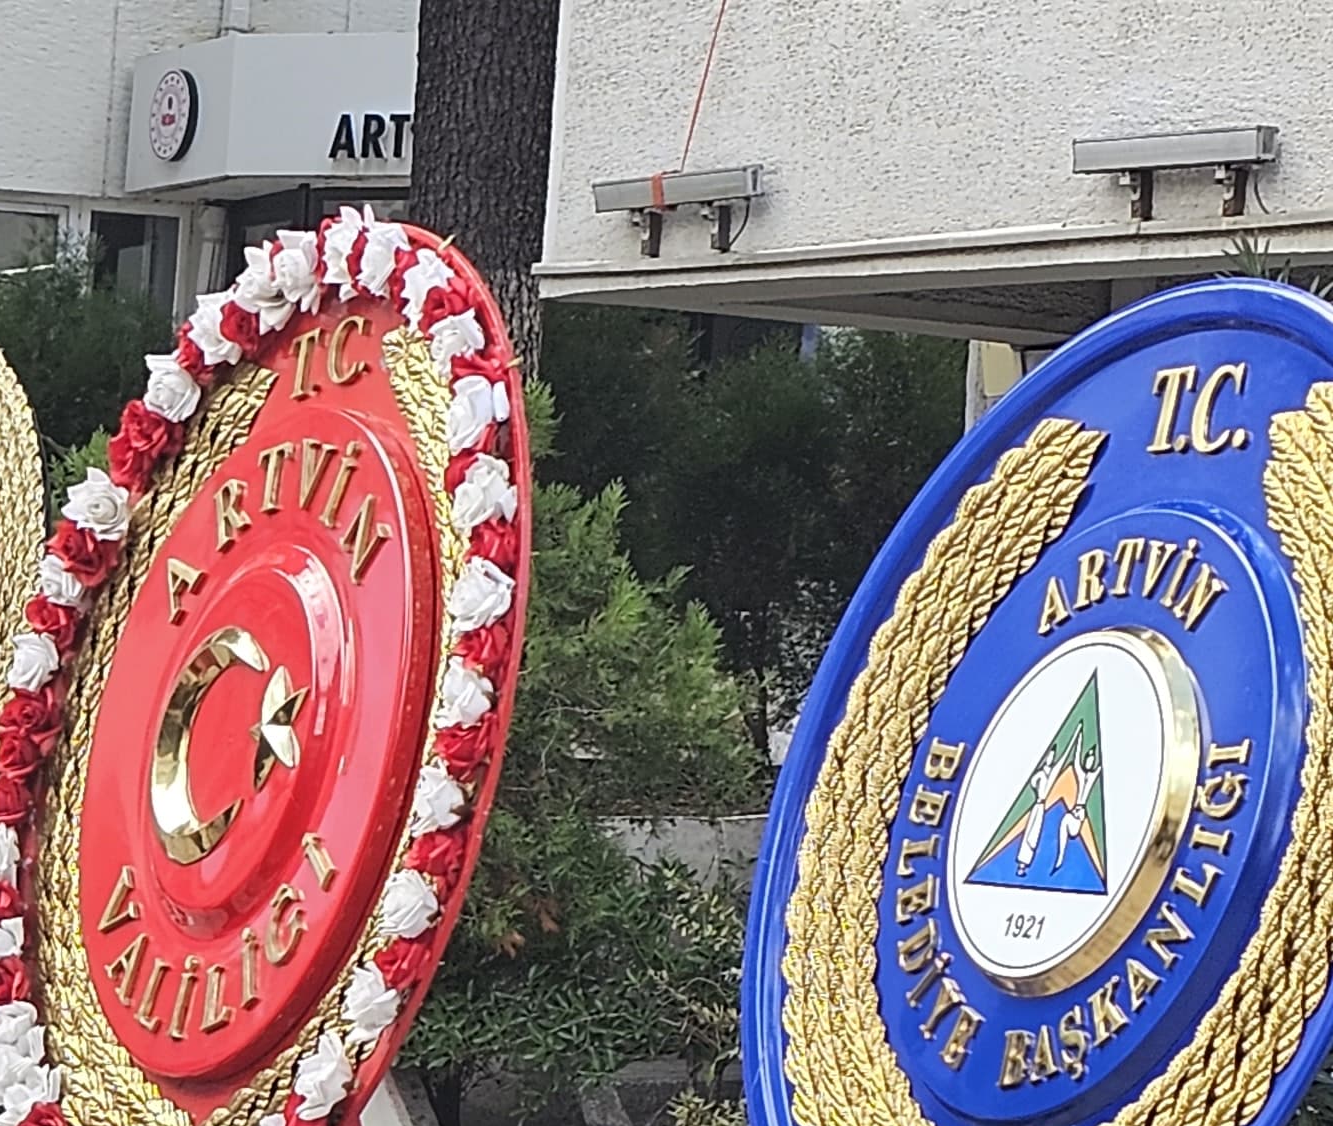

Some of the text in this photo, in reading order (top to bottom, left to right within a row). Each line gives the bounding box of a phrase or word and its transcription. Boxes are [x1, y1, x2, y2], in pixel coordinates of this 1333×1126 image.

[328, 113, 415, 159] ART
[1146, 362, 1247, 454] T.C.
[167, 438, 394, 628] ARTVİN
[1038, 538, 1229, 637] ARTVİN
[896, 737, 986, 1072] BELEDİYE
[1005, 913, 1045, 940] 1921
